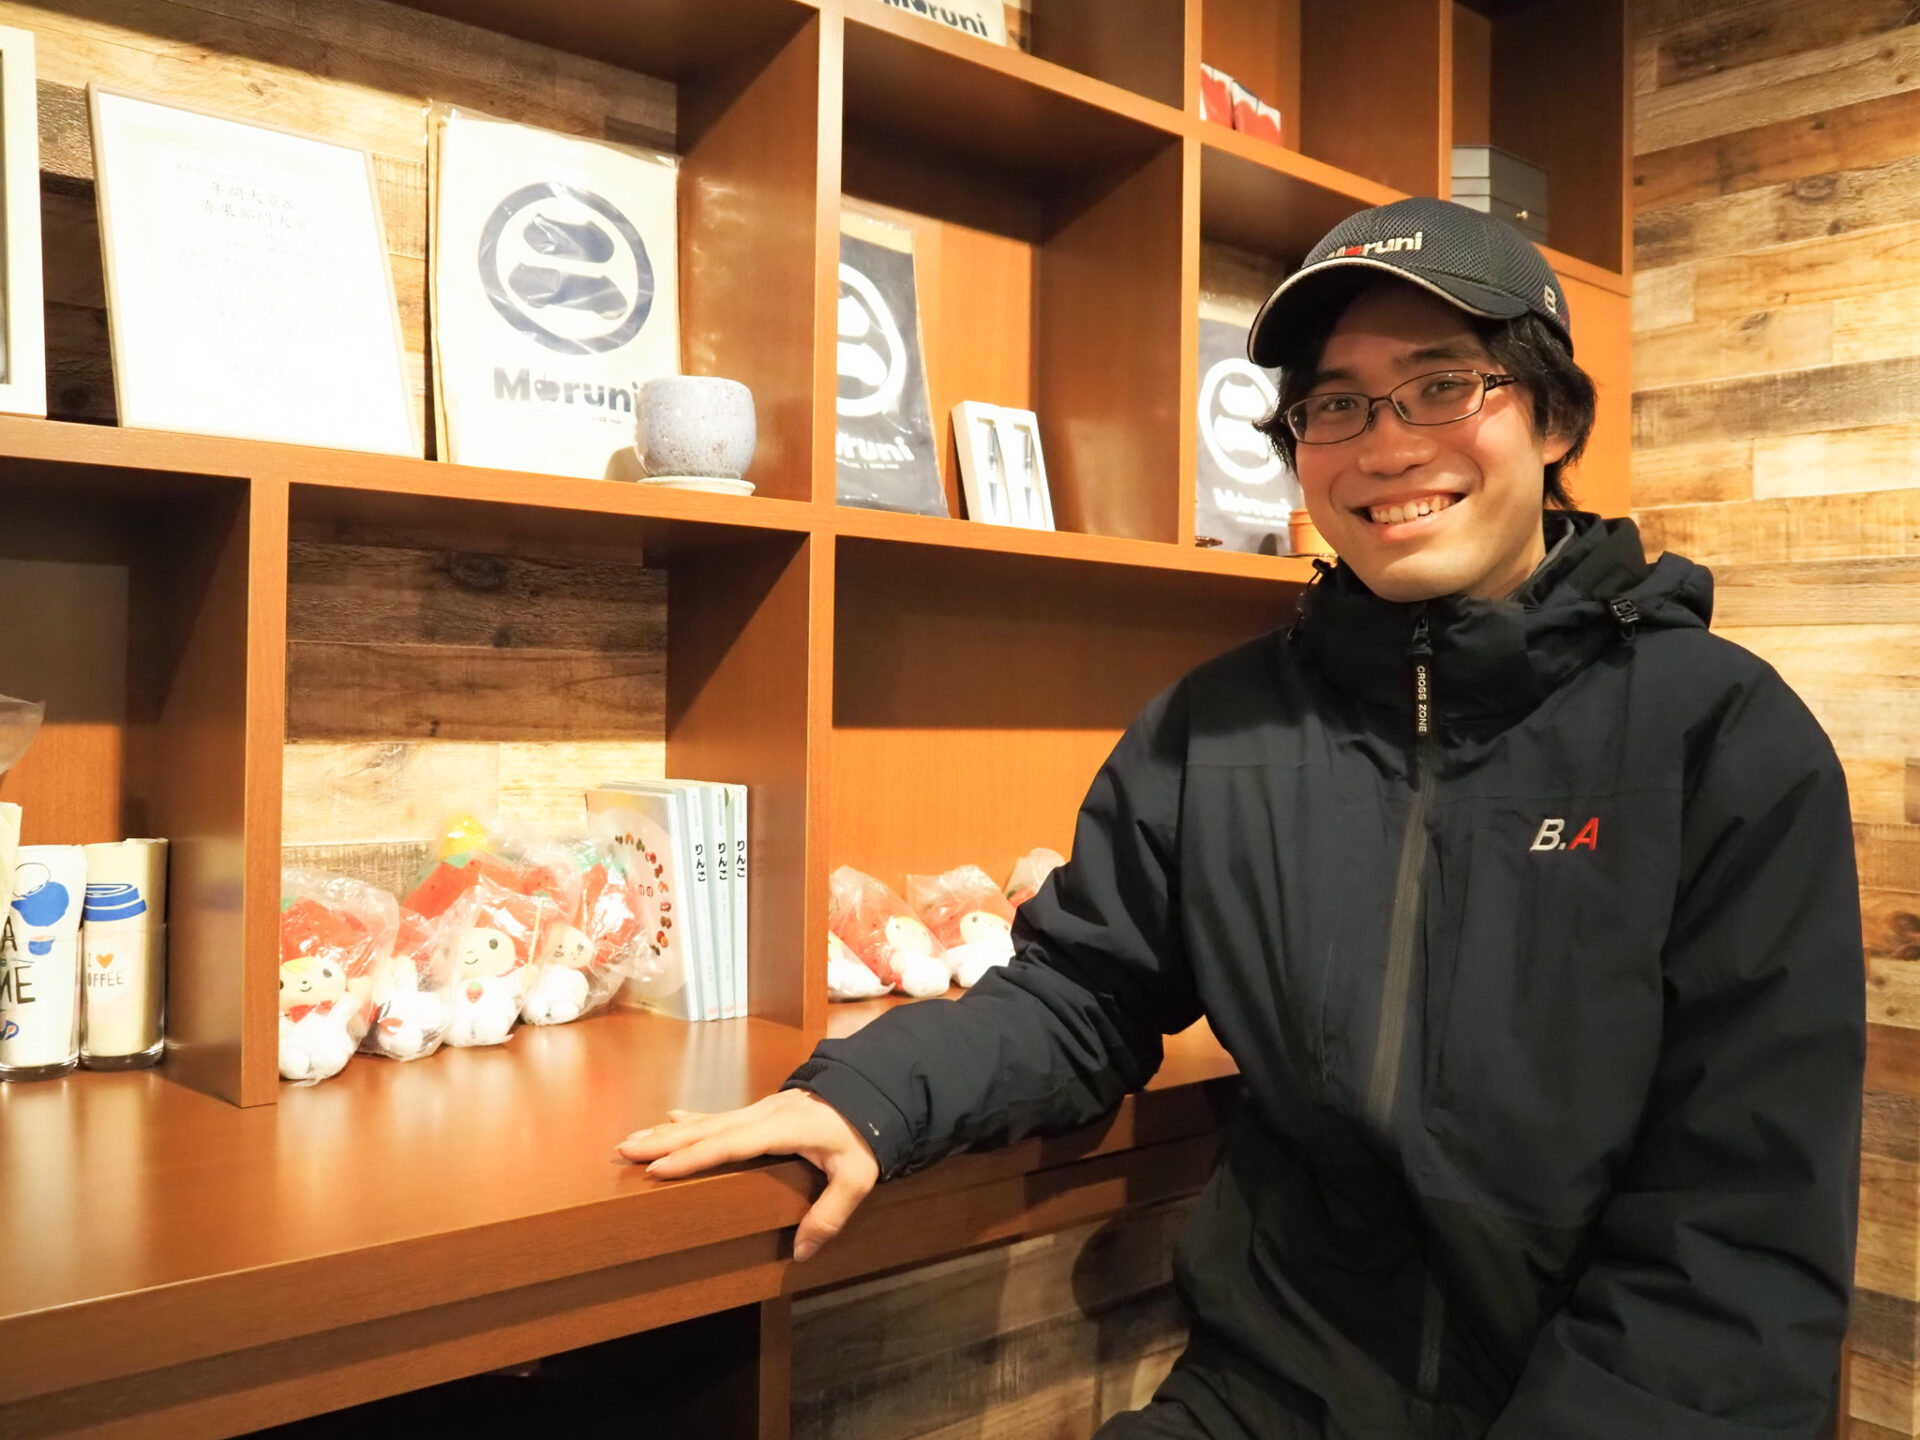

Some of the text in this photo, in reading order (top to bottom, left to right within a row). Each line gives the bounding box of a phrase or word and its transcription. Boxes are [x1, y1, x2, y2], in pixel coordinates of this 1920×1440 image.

[1416, 665, 1427, 733] CROSS ZONE
[1529, 816, 1600, 851] B.A
